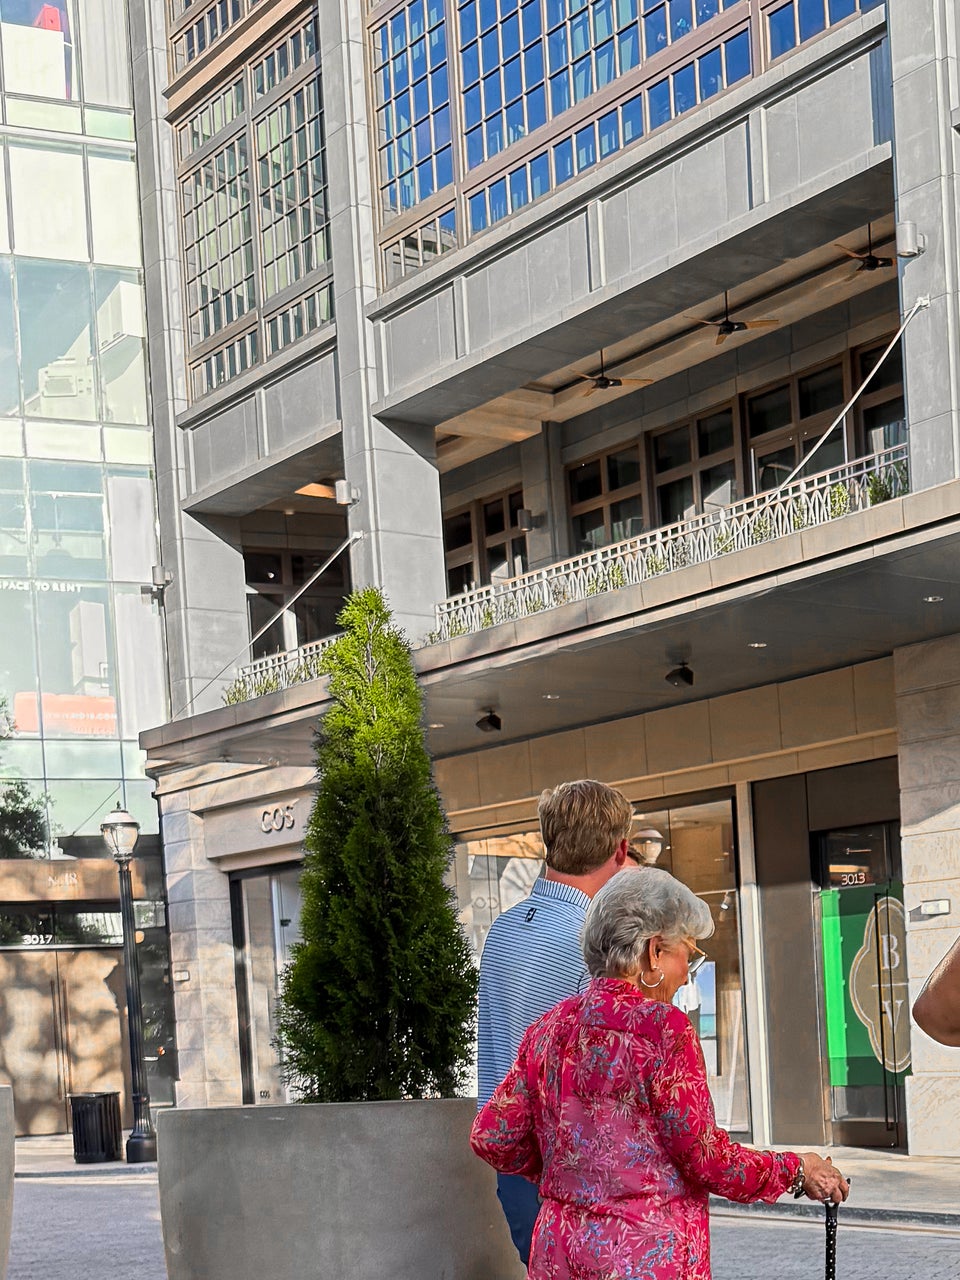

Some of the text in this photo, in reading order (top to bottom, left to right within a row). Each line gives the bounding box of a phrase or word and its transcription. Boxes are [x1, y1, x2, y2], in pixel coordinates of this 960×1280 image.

[34, 582, 50, 591] TO
[52, 582, 83, 593] RENT
[261, 805, 295, 834] COS
[841, 872, 866, 886] 3013
[22, 934, 53, 946] 3017
[881, 934, 900, 970] B
[882, 999, 904, 1034] V
